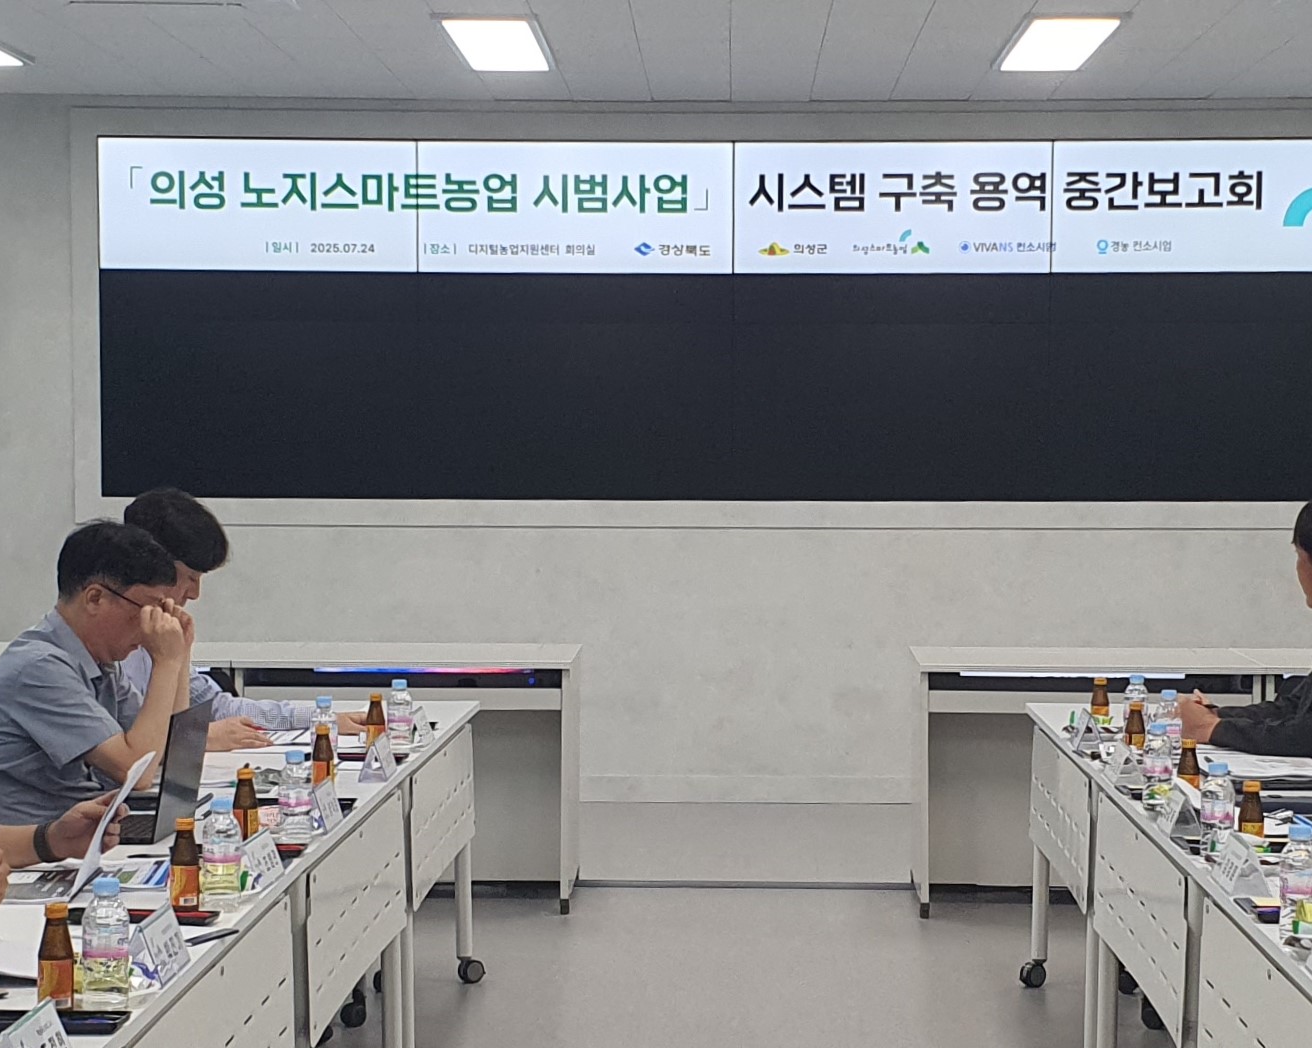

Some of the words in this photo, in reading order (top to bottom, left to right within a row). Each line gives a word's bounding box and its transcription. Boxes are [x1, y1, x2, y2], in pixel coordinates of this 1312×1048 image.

[240, 171, 519, 214] 노지스마트농업
[748, 172, 866, 213] 시스템
[878, 171, 958, 213] 구축
[969, 172, 1049, 213] 용역
[1062, 170, 1264, 212] 중간보고회
[310, 243, 375, 253] 2025.07.24
[468, 243, 560, 256] 디지털농업지원센터
[565, 244, 596, 256] 회의실
[658, 244, 712, 257] 경상북도
[793, 243, 828, 255] 의성군
[972, 242, 1014, 253] VIVANS
